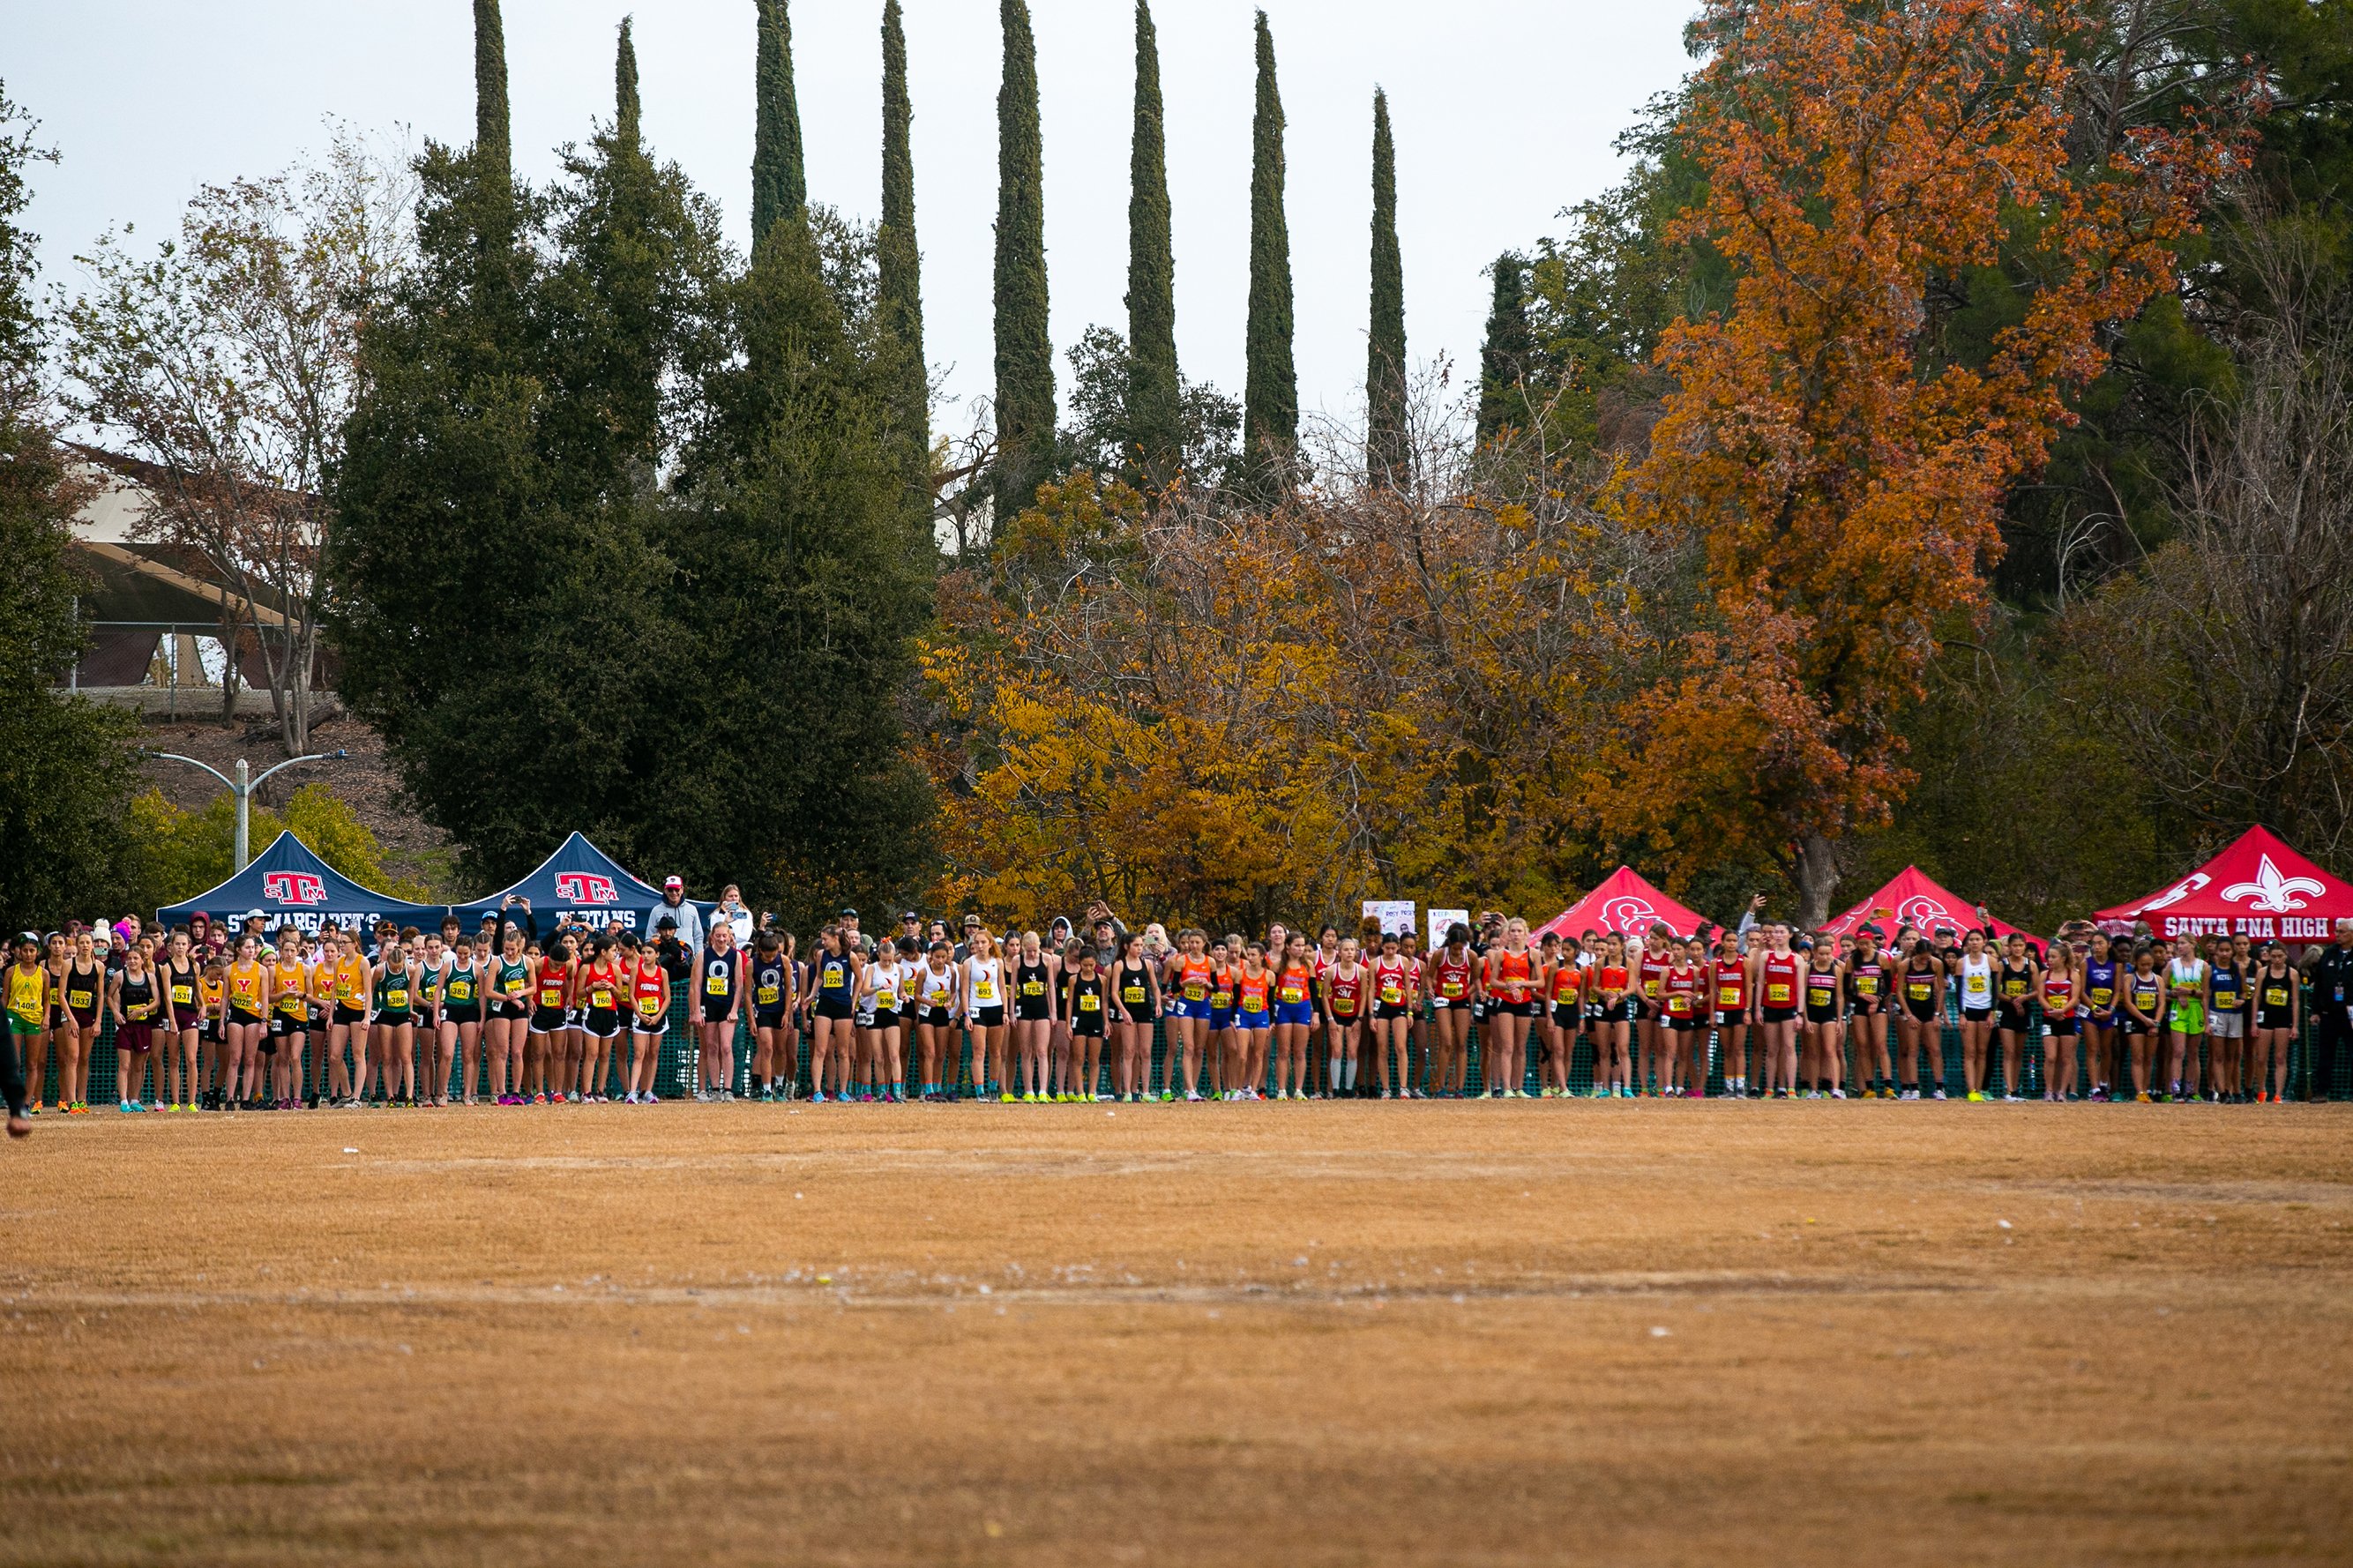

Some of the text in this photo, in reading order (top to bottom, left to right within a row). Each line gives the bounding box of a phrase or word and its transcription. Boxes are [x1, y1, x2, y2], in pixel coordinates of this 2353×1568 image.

[2164, 917, 2329, 937] SANTA ANA HIGH
[237, 979, 251, 992] Y
[17, 1002, 35, 1011] 1405
[71, 997, 89, 1005] 1533
